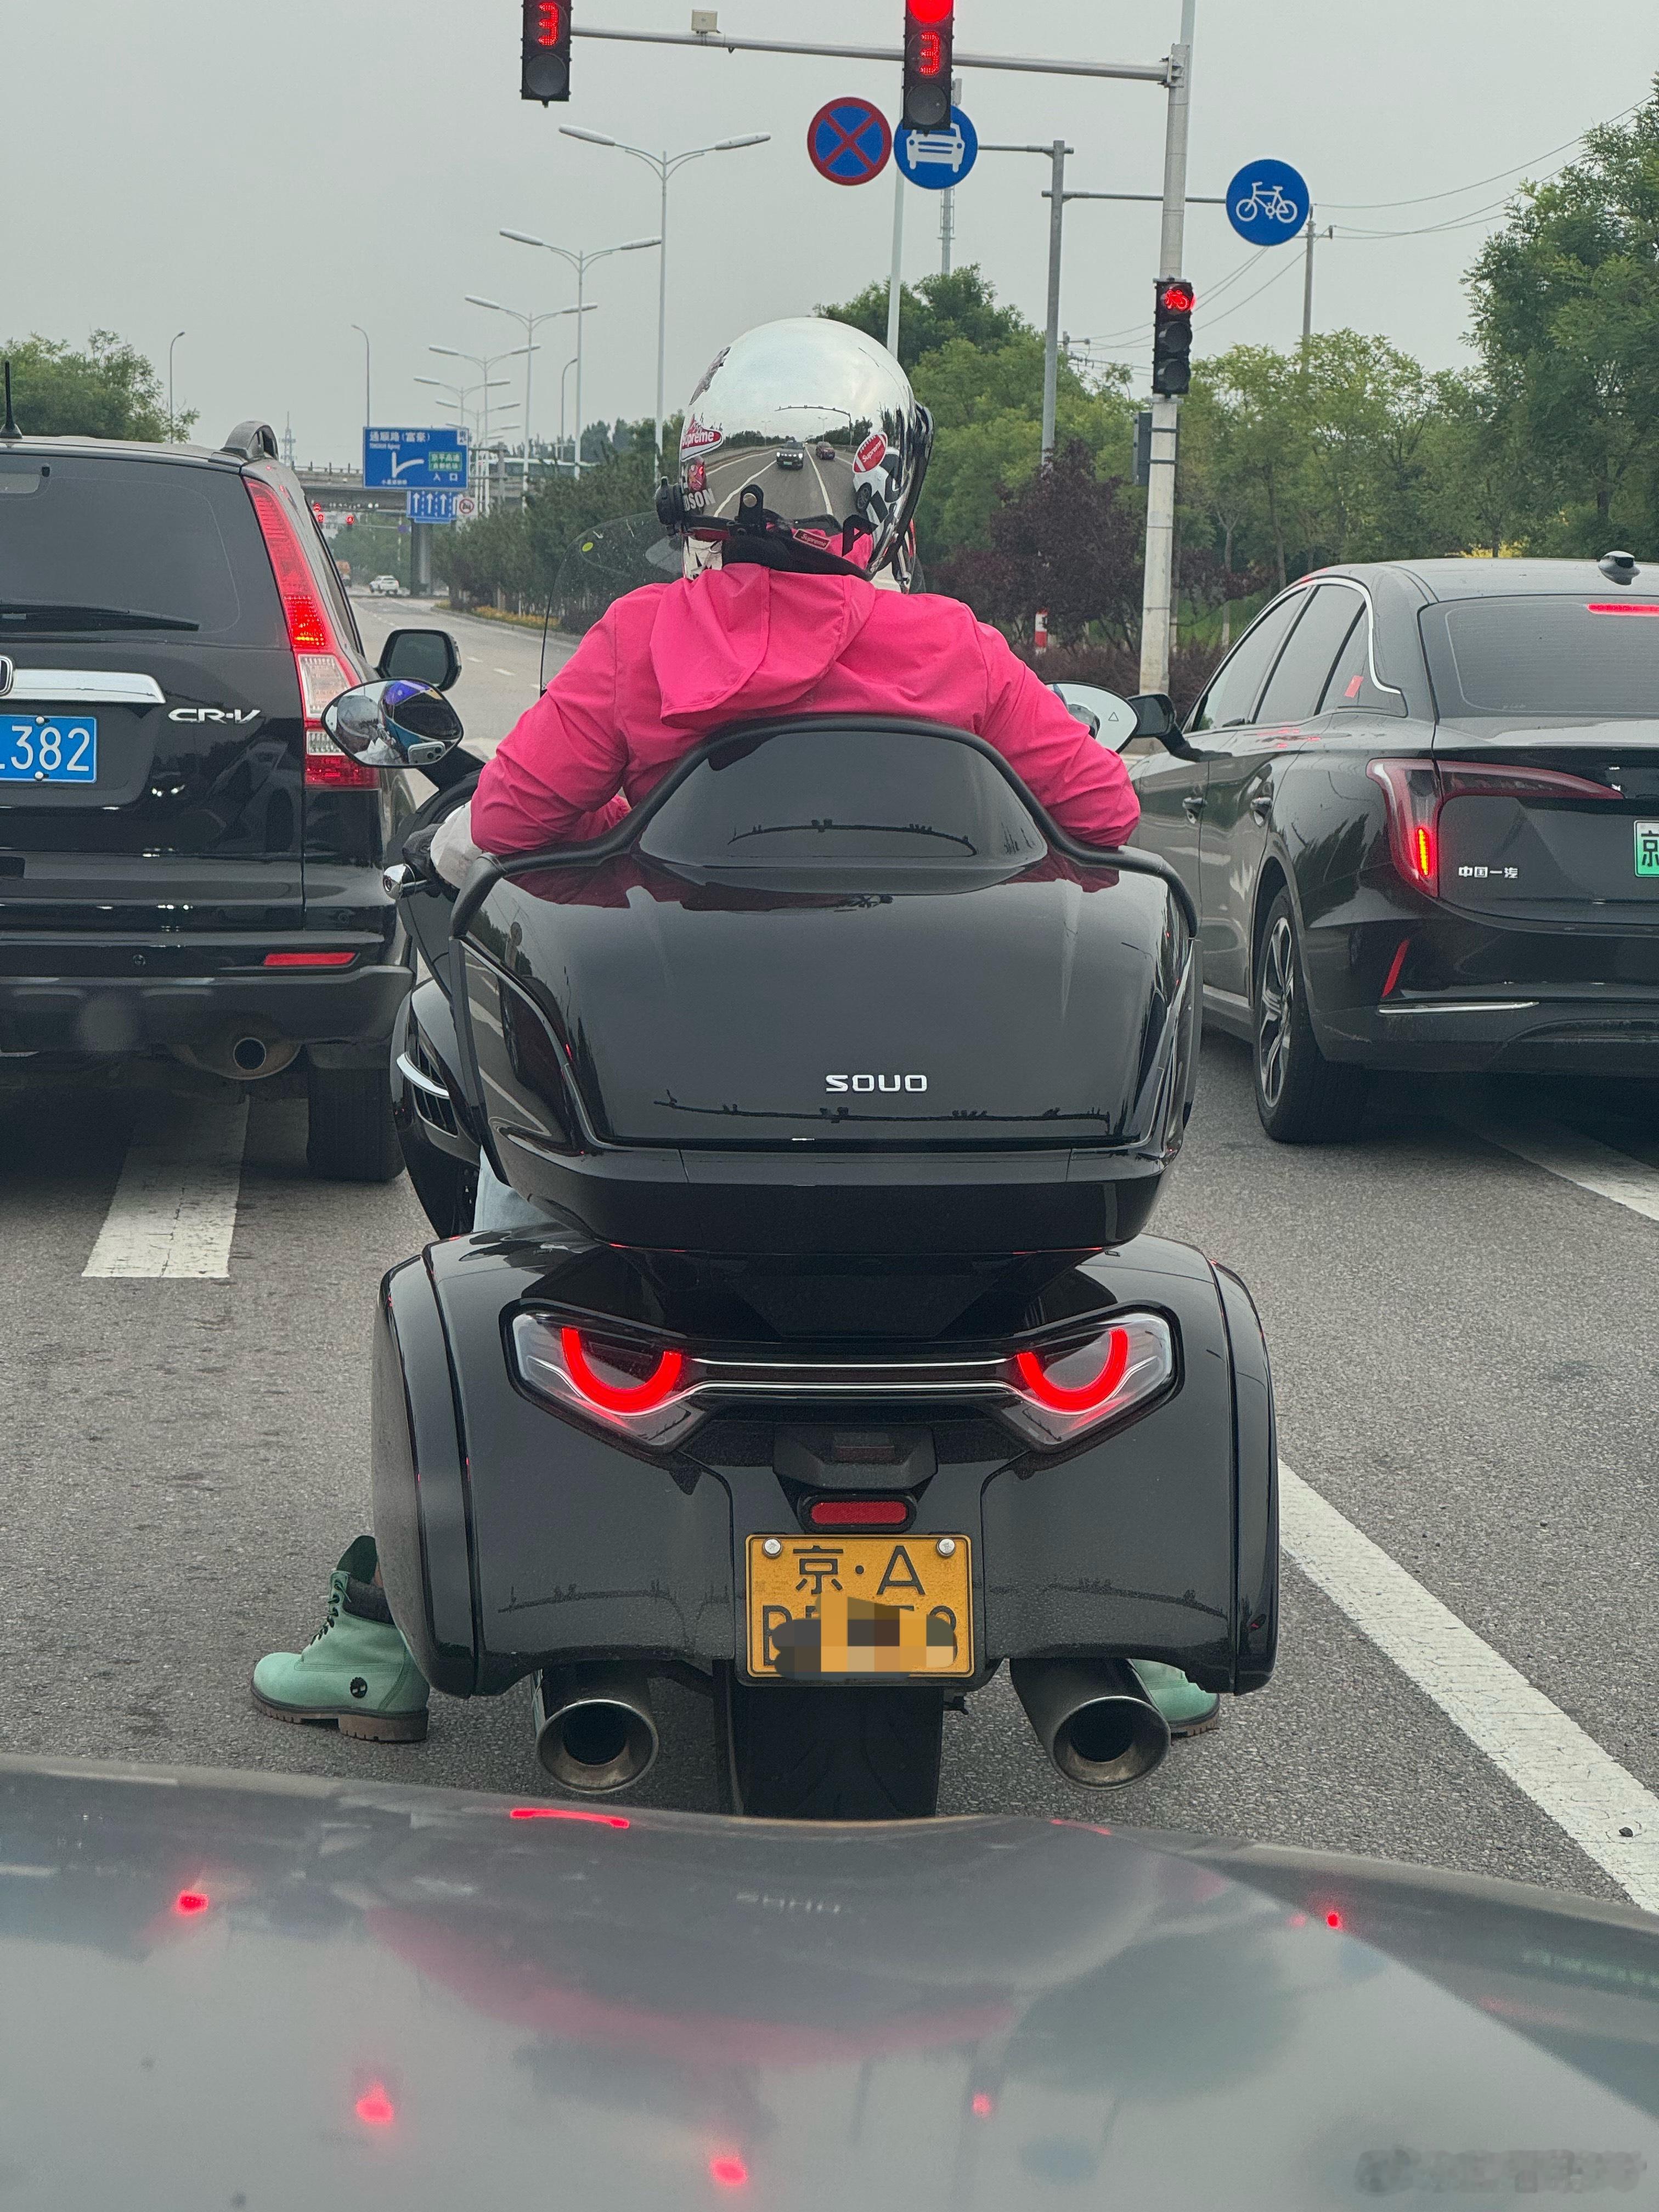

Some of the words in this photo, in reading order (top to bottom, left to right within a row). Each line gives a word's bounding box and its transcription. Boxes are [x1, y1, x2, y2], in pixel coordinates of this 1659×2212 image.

[539, 2, 558, 46] 3
[921, 31, 940, 75] 3
[682, 431, 714, 448] upreme
[168, 708, 261, 724] CR-V
[0, 725, 90, 771] 382
[1641, 830, 1659, 867] 京
[1458, 866, 1519, 879] 中国一汽
[826, 1075, 927, 1092] SOUO
